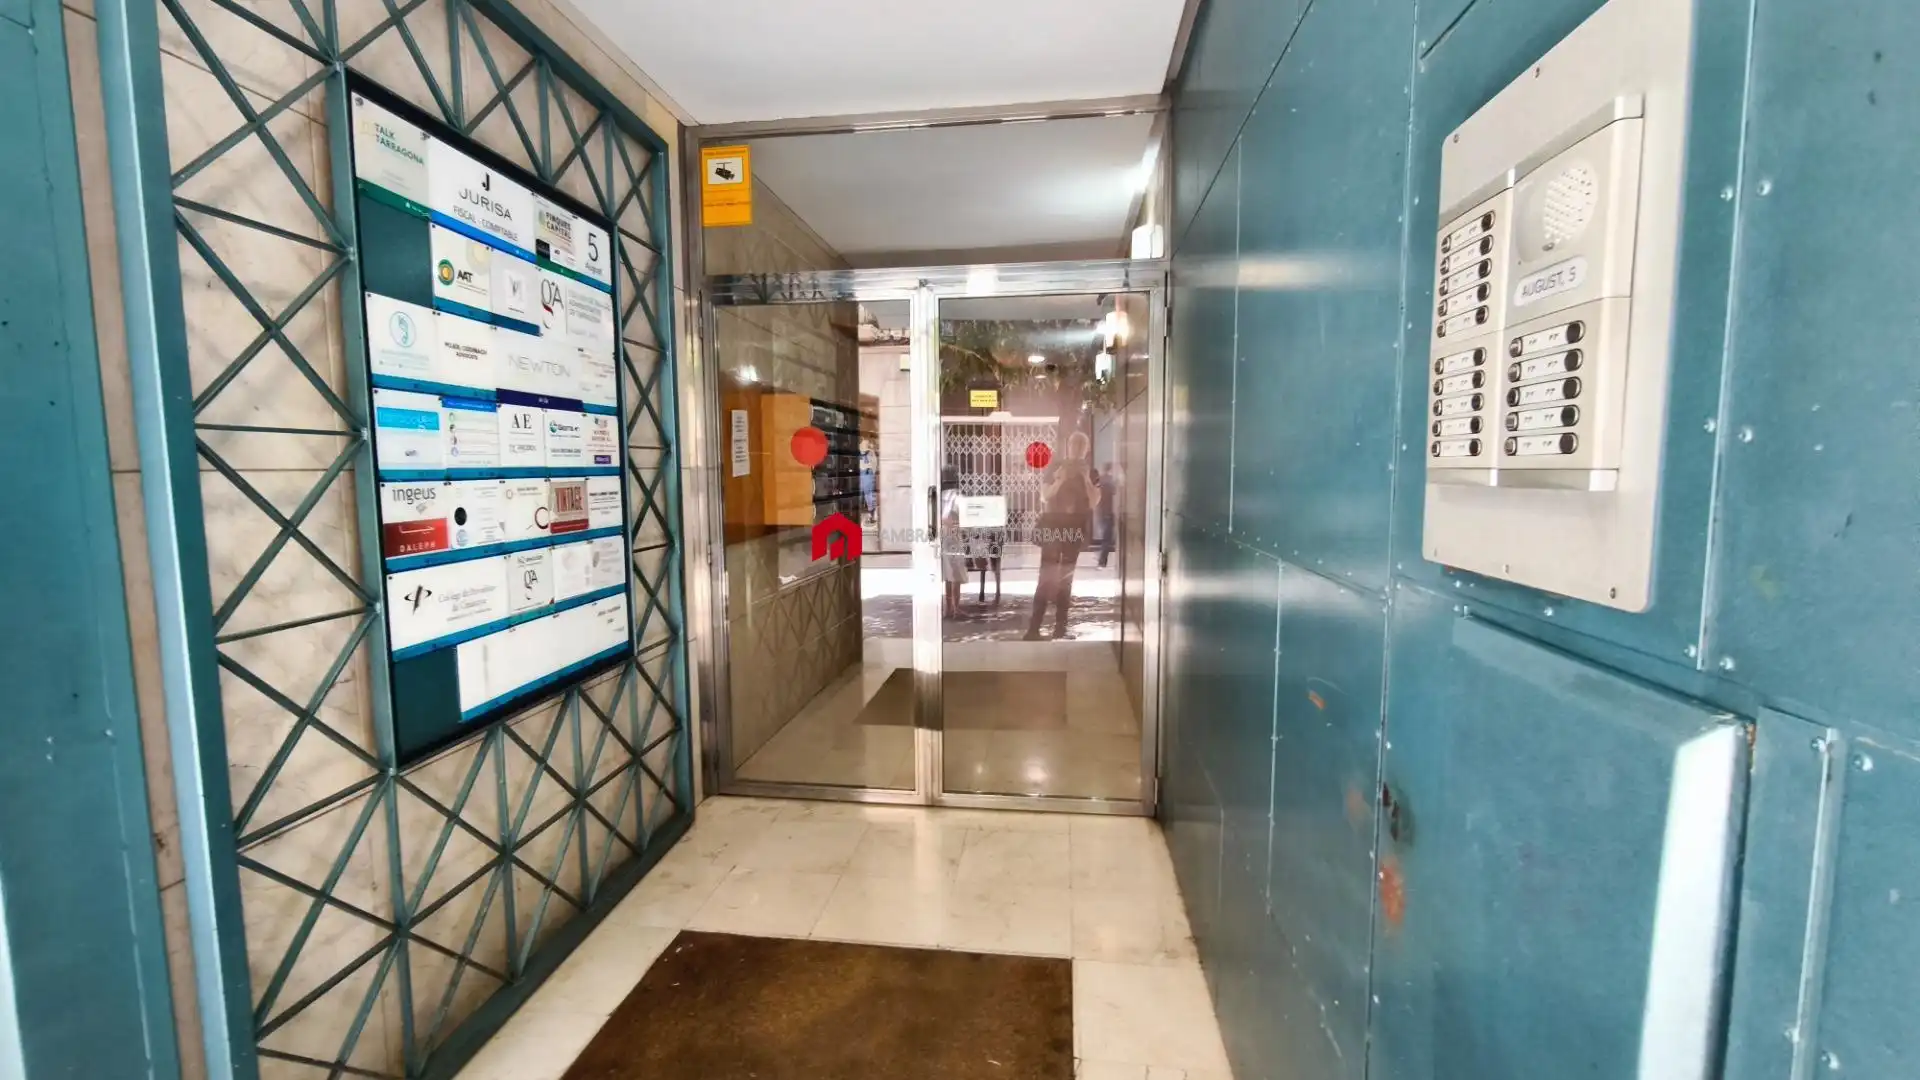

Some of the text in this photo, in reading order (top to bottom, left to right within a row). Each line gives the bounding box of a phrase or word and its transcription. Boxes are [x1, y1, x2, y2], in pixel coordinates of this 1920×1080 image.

[375, 121, 396, 140] TALK
[375, 134, 425, 165] TARRAGONA
[482, 172, 490, 191] J
[459, 187, 512, 221] JURISA
[453, 204, 477, 224] FISCAL
[546, 221, 572, 240] CAPITAL
[588, 232, 599, 262] 5
[1568, 265, 1576, 282] 5
[507, 354, 571, 378] NEWTON
[392, 487, 436, 505] ingeus
